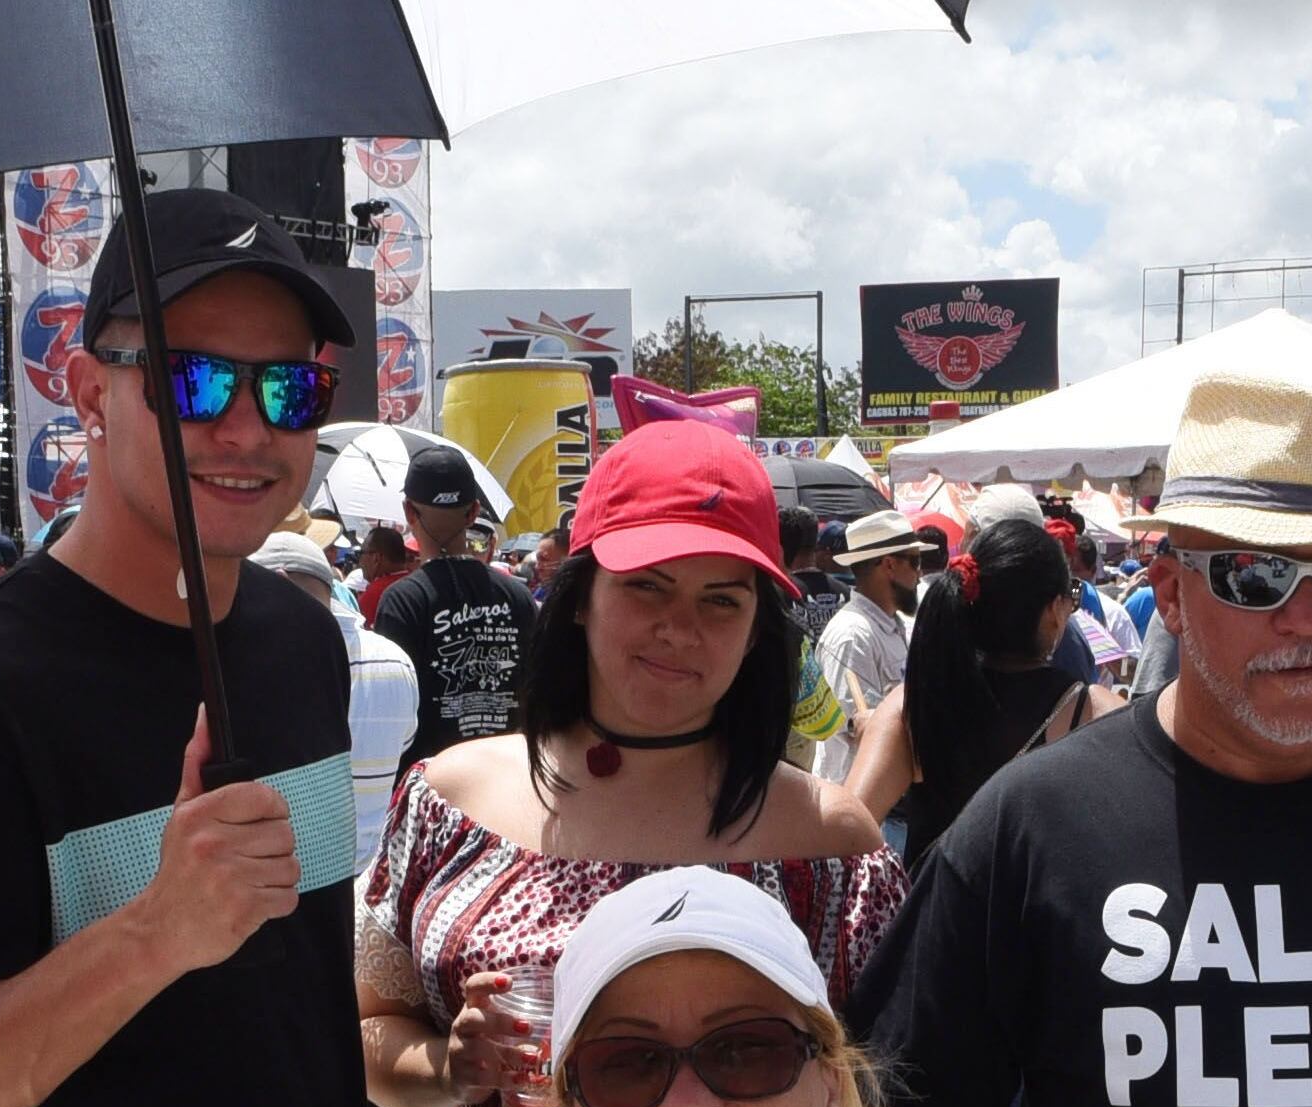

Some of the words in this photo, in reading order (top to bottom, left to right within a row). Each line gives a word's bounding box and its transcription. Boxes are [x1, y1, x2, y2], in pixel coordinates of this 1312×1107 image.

[41, 240, 79, 266] 93
[901, 304, 943, 332] THE
[947, 301, 1016, 331] WINGS
[870, 392, 913, 406] FAMILY
[915, 390, 998, 405] RESTAURANT
[433, 602, 511, 634] Salseros
